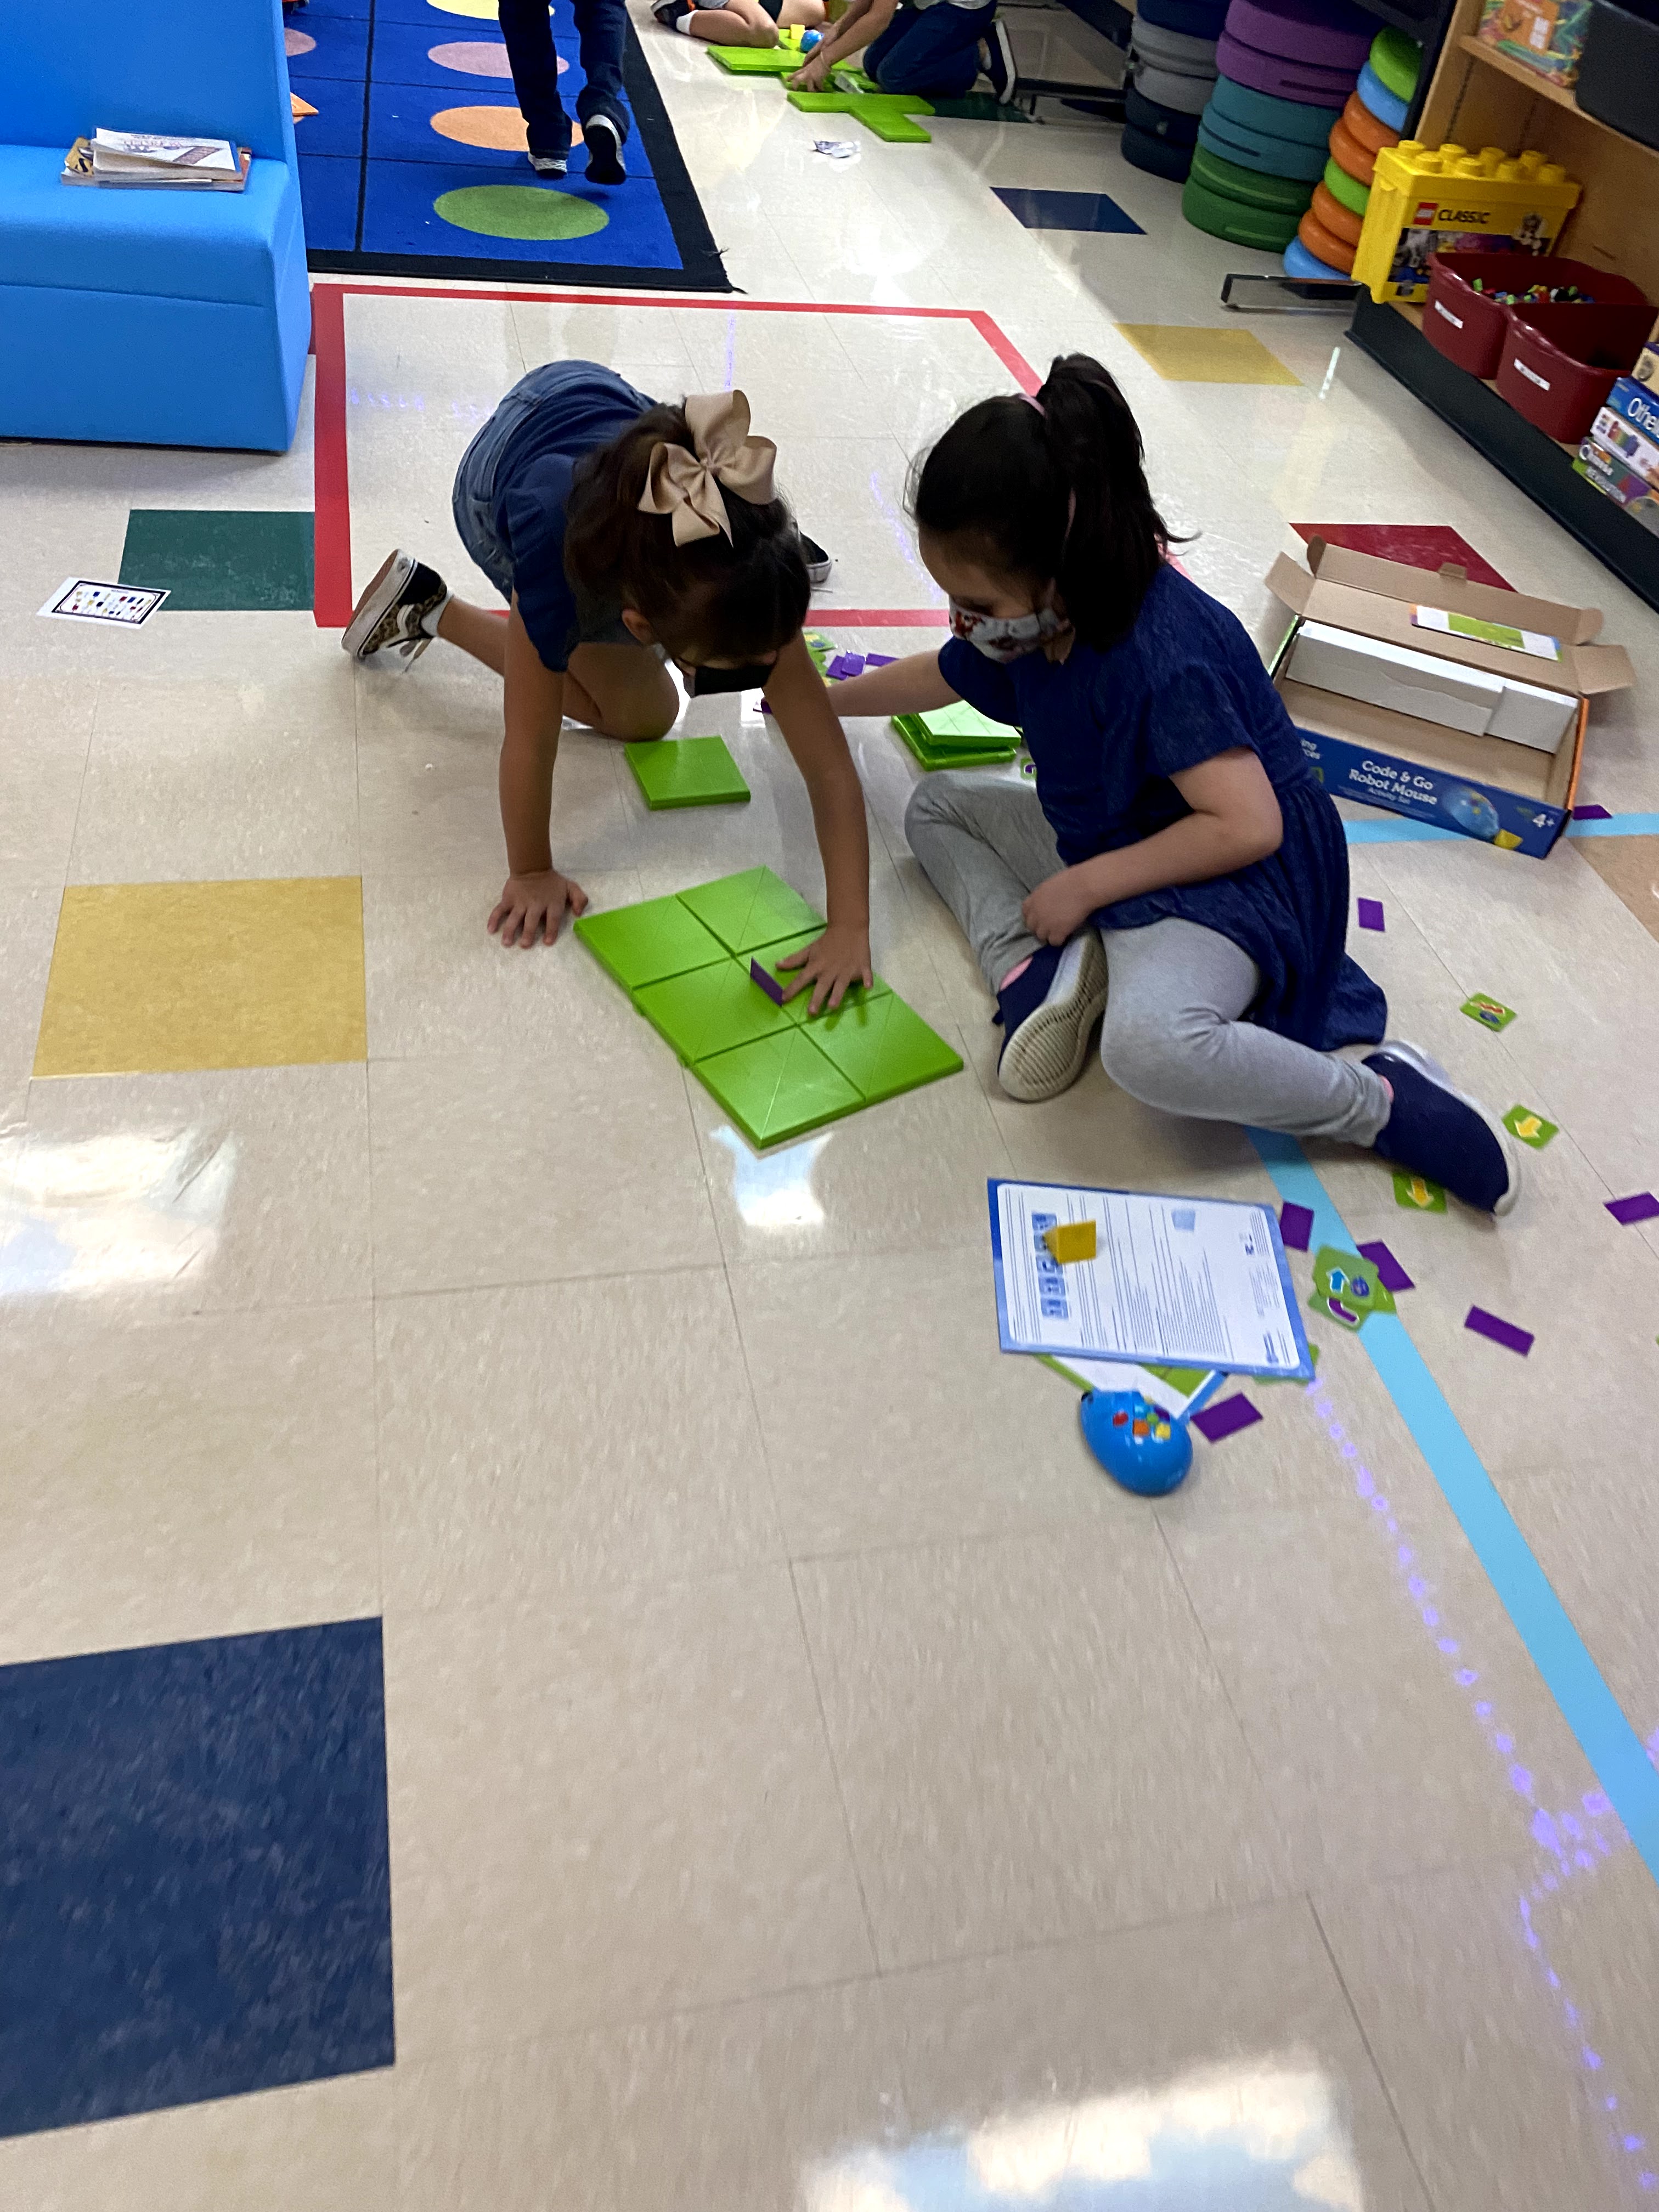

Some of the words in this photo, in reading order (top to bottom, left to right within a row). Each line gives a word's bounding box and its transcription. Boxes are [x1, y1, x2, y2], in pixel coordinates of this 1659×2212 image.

[1438, 209, 1491, 224] CLASSIC
[1362, 760, 1398, 779] Code
[1400, 771, 1410, 782] &
[1413, 776, 1434, 790] Go
[1348, 768, 1390, 790] Robot
[1392, 782, 1437, 805] Mouse
[1532, 814, 1555, 828] 4+
